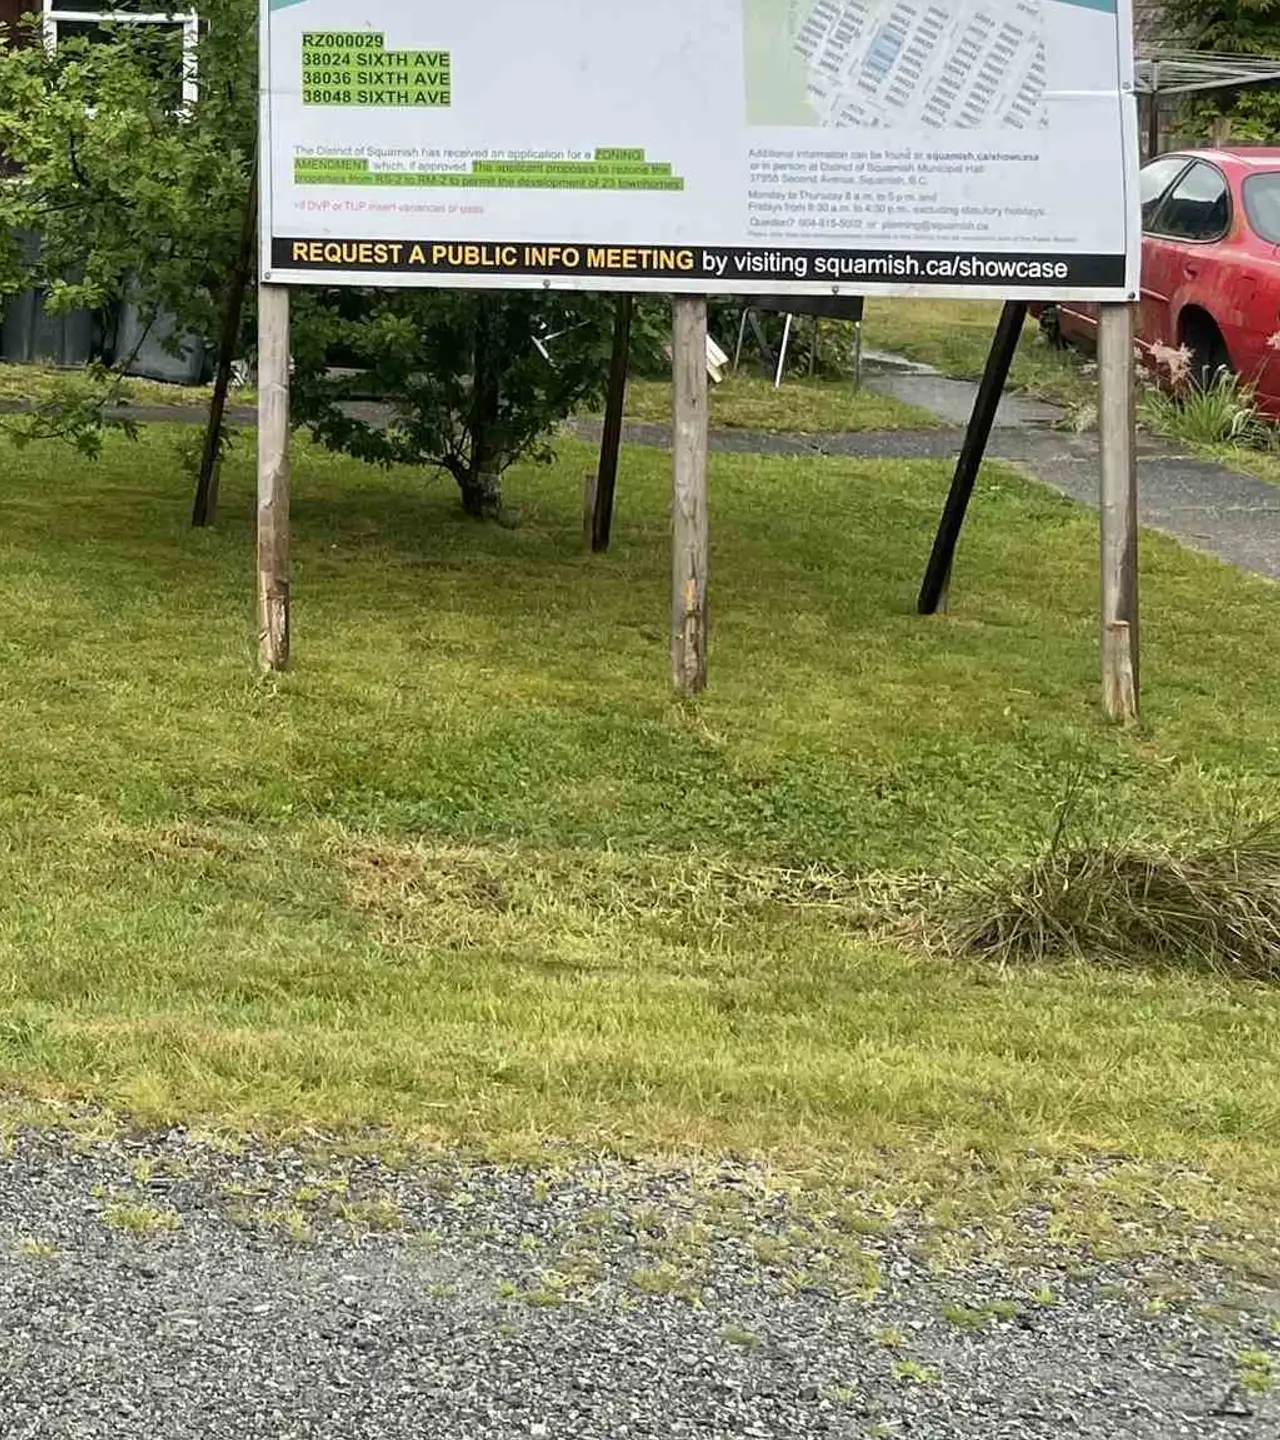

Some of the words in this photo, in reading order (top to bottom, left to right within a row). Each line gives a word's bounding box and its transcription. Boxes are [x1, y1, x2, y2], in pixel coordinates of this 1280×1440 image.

[302, 33, 384, 48] RZ000029
[302, 52, 352, 66] 38024
[357, 52, 409, 66] SIXTH
[414, 52, 451, 67] AVE
[302, 72, 352, 86] 38036
[357, 72, 409, 86] SIXTH
[414, 72, 451, 86] AVE
[302, 90, 352, 104] 38048
[357, 90, 409, 104] SIXTH
[414, 90, 451, 104] AVE
[291, 241, 403, 264] REQUEST
[408, 245, 426, 265] A
[432, 246, 518, 267] PUBLIC
[524, 247, 580, 268] INFO
[587, 249, 694, 270] MEETING
[702, 250, 728, 276] by
[734, 251, 808, 277] visiting
[814, 253, 1069, 279] squamish.ca/showcase
